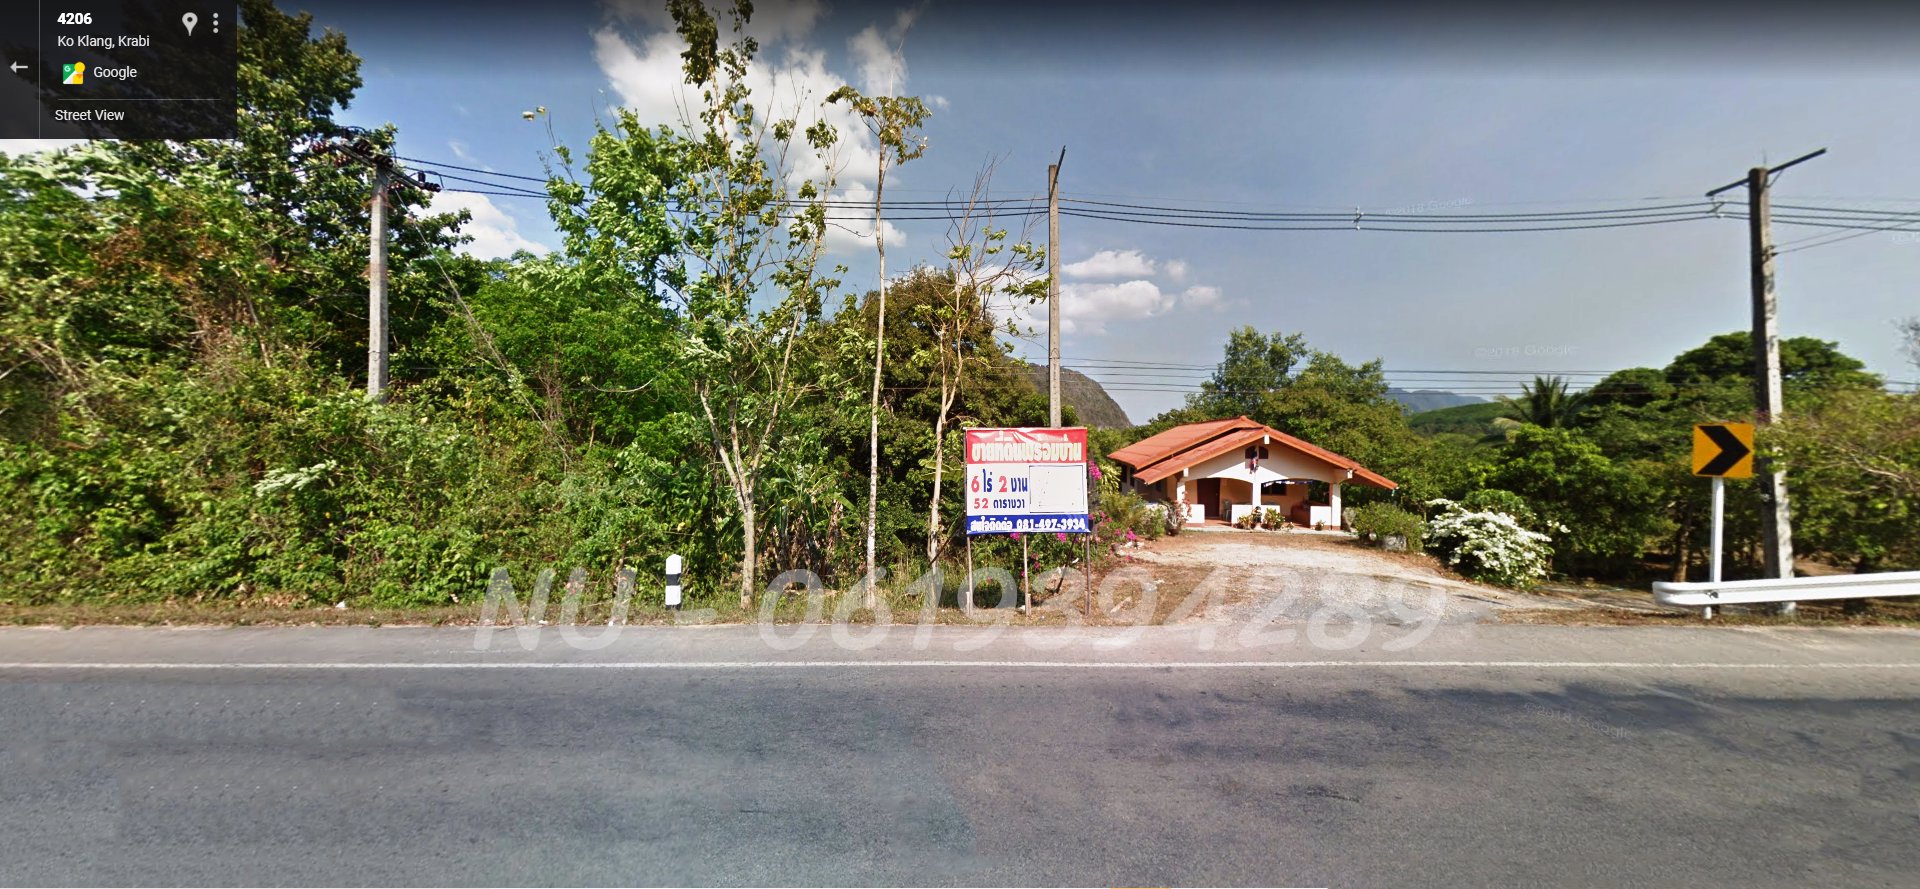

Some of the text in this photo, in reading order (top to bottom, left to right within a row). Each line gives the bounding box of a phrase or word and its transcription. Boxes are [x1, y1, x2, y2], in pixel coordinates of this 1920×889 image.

[971, 468, 1028, 493] 6 ไร่ 2 งาน
[973, 498, 1025, 509] 52 ตารางวา
[1016, 518, 1086, 530] 081-497-3934
